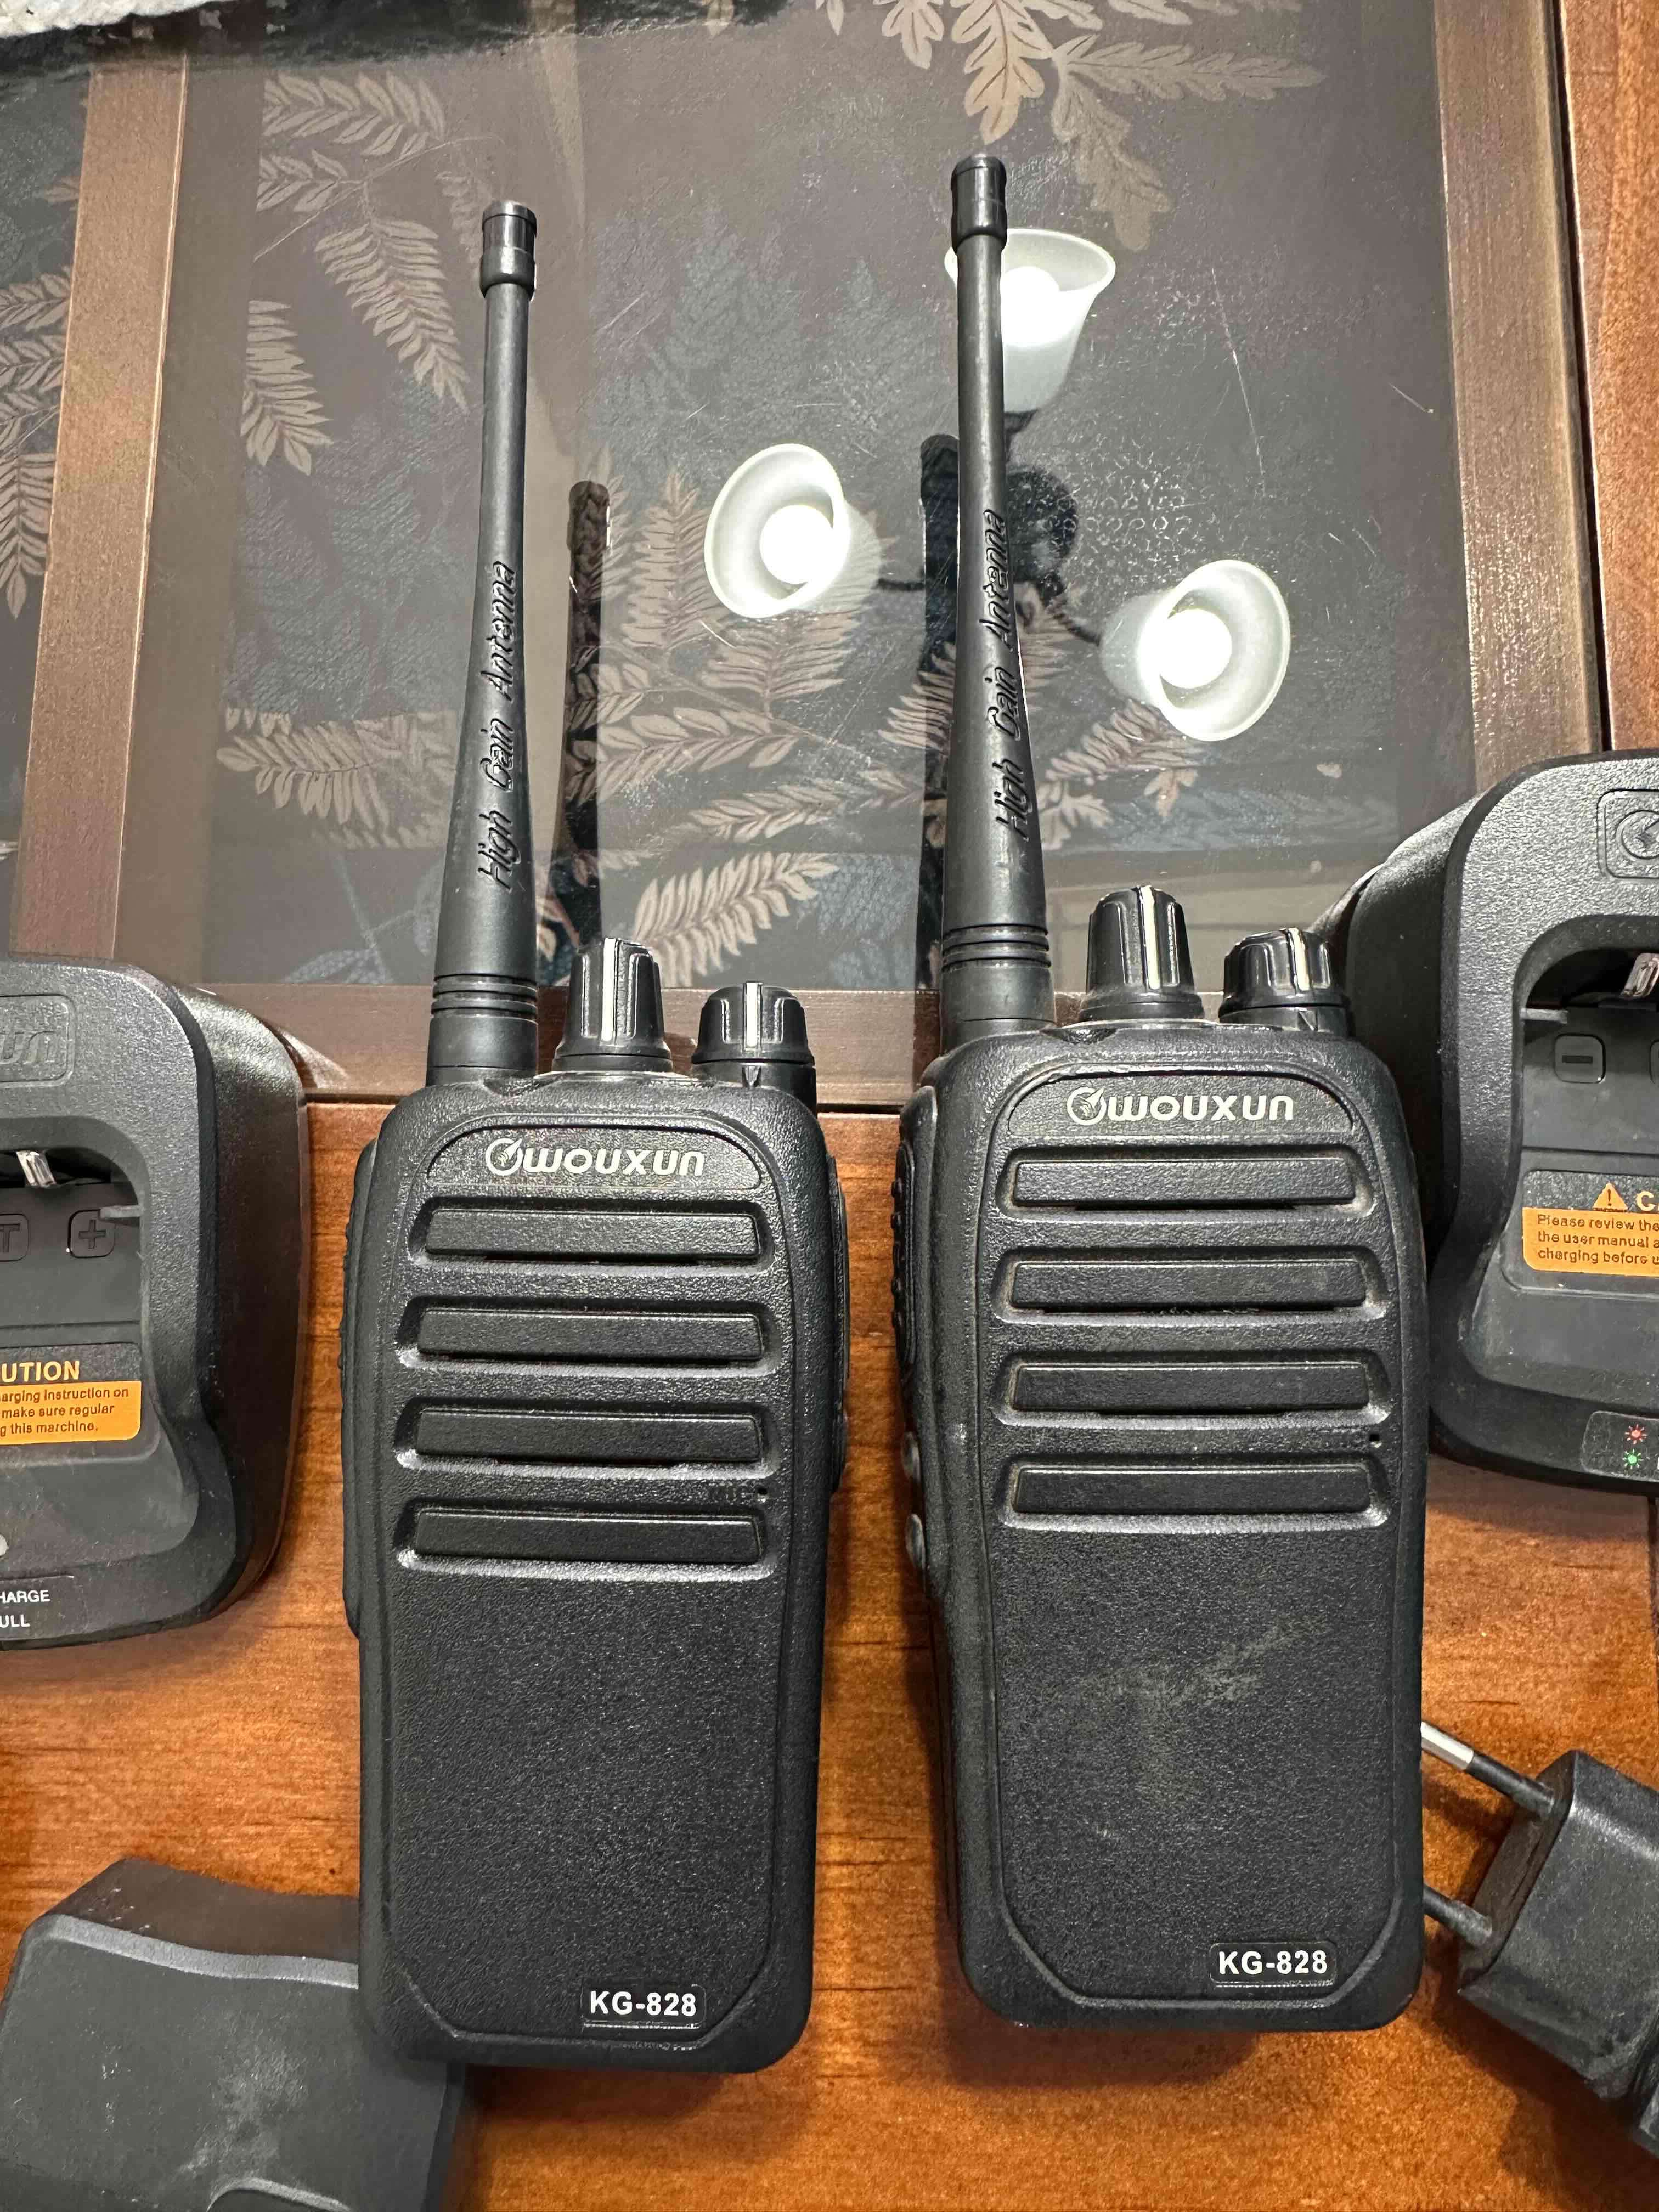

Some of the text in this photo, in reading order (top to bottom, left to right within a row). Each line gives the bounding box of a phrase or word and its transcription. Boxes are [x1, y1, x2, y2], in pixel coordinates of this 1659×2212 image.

[979, 509, 1032, 842] High Gain Antenna
[478, 561, 521, 890] High Gain Antenna
[1537, 1214, 1659, 1232] Please review the
[1538, 1230, 1560, 1243] the
[1564, 1234, 1595, 1245] user
[1598, 1235, 1649, 1248] manual
[1538, 1247, 1598, 1265] charging
[1603, 1251, 1648, 1265] before
[2, 1361, 80, 1383] UTION
[0, 1389, 40, 1404] arging
[114, 1388, 129, 1398] on
[2, 1403, 115, 1418] make sure regular
[10, 1422, 32, 1435] this
[36, 1420, 98, 1434] marchine.
[1219, 1950, 1327, 1975] KG-828
[590, 1990, 696, 2017] KG-828
